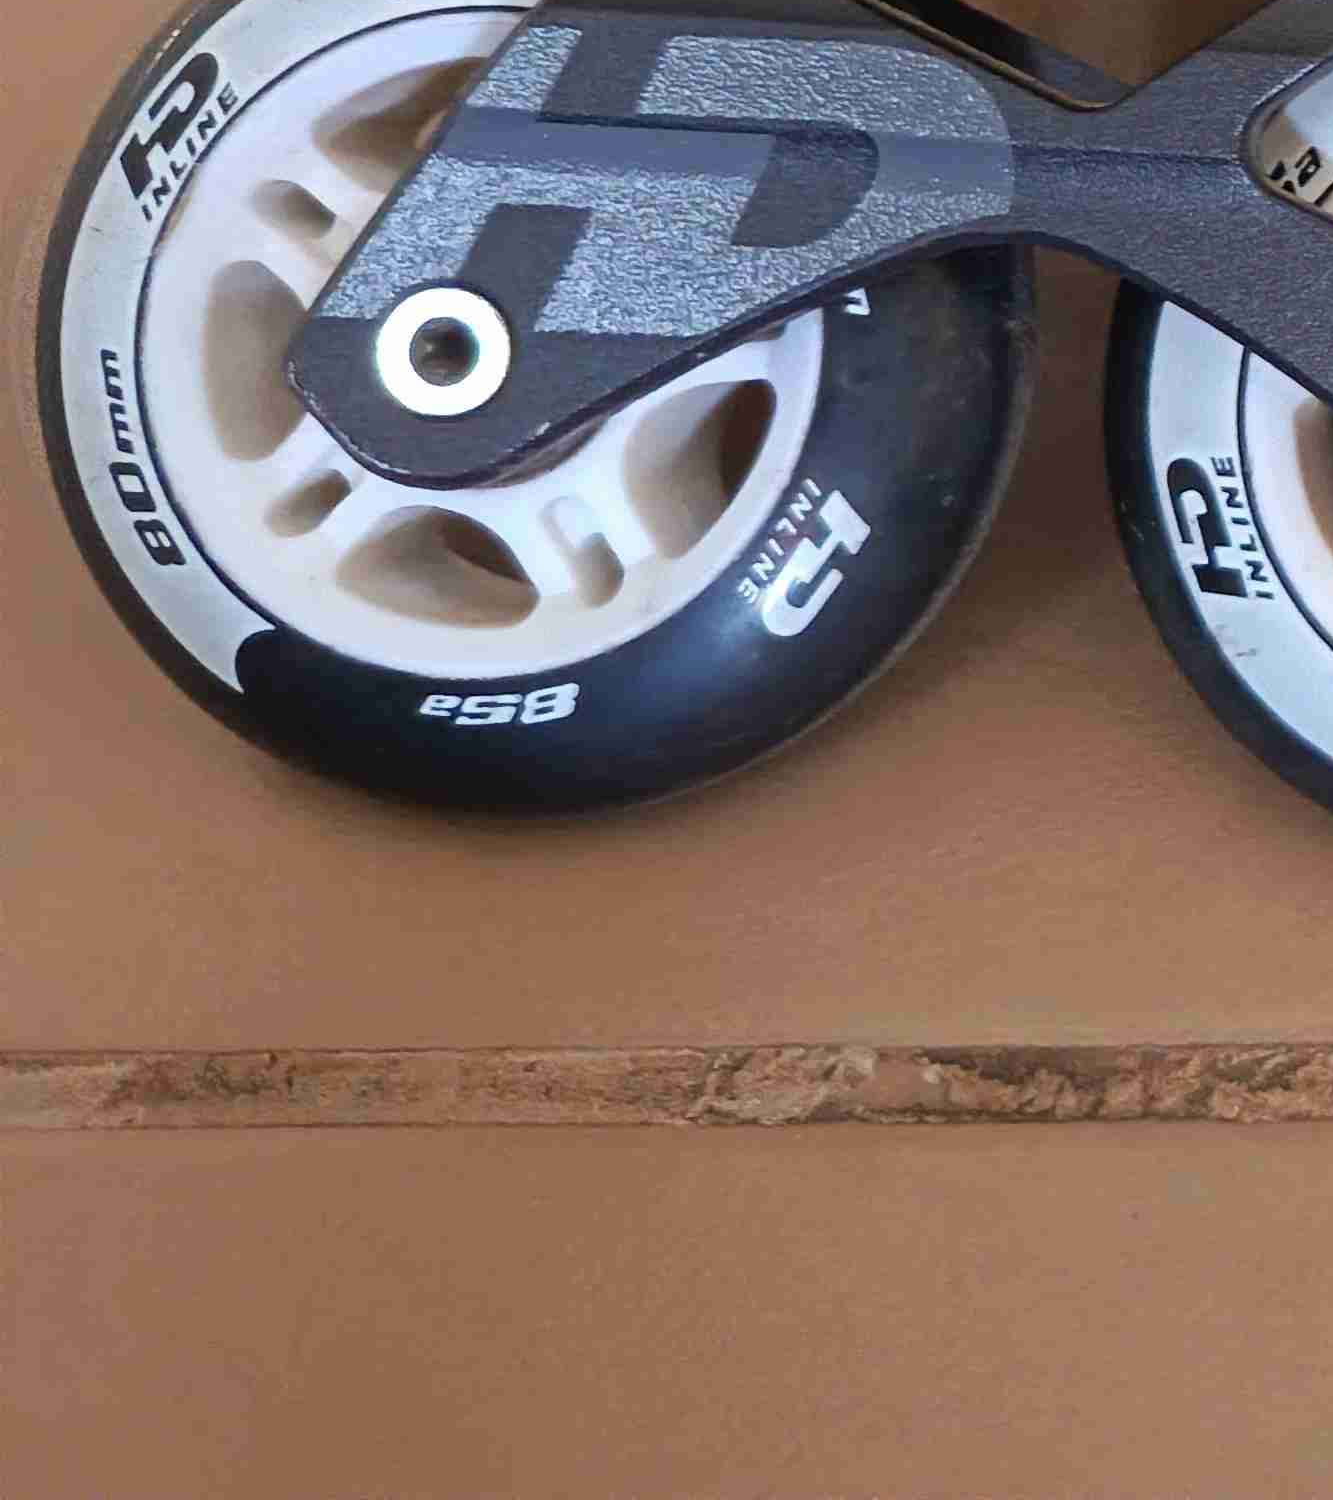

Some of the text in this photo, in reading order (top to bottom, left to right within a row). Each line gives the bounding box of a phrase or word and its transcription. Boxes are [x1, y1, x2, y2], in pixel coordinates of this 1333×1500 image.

[140, 81, 238, 221] INLINE
[98, 345, 185, 568] 80mm
[737, 478, 822, 603] INLINE
[1214, 453, 1276, 602] INLINE
[419, 682, 580, 727] 85a
